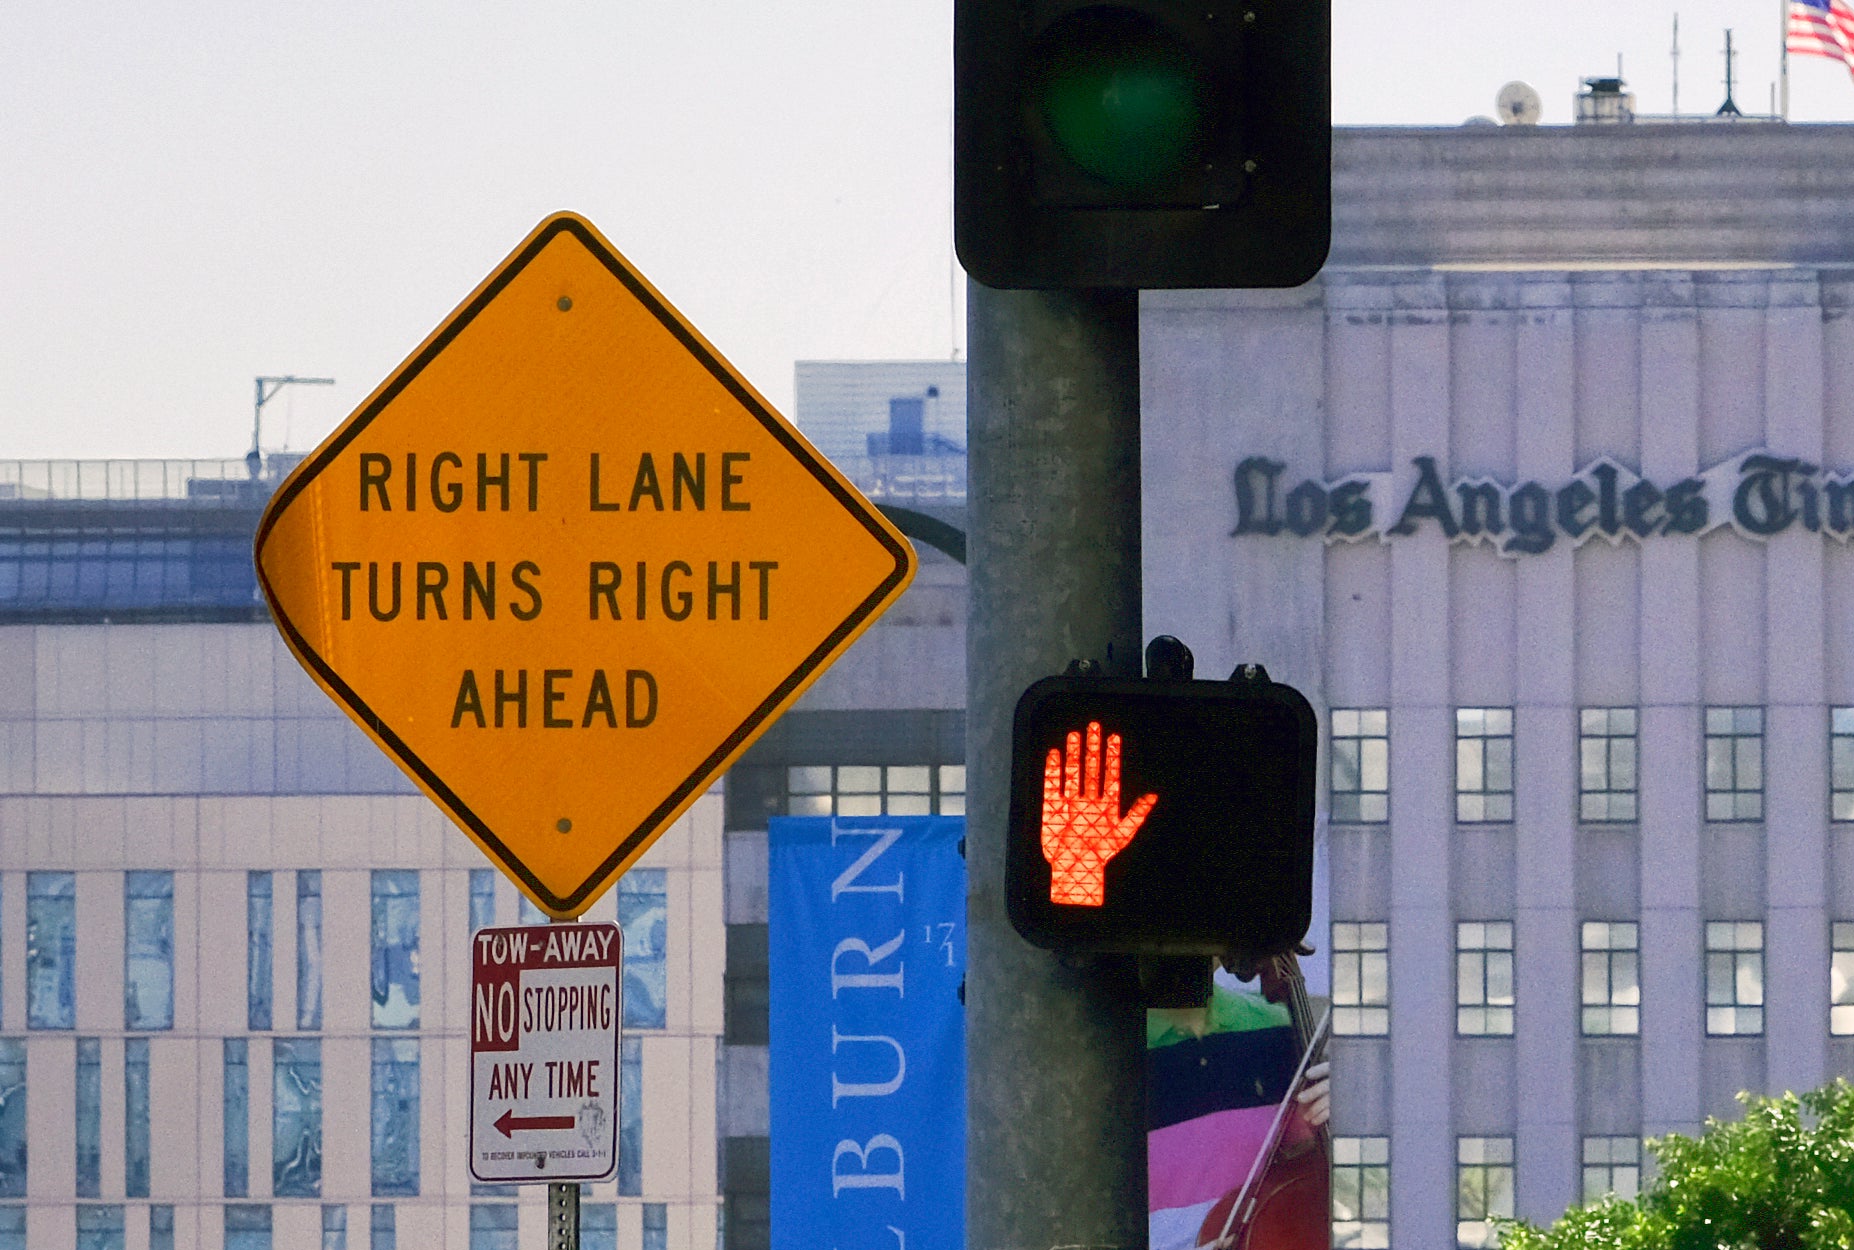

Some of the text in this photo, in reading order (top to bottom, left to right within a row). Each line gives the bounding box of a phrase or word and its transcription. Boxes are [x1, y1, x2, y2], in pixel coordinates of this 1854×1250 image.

[358, 452, 752, 513] RIGHT LANE
[1230, 455, 1374, 537] Los
[1386, 455, 1710, 556] Angeles
[332, 561, 780, 622] TURNS RIGHT
[450, 668, 659, 729] AHEAD
[477, 929, 616, 965] TOW-AWAY
[944, 941, 957, 968] 1
[475, 981, 611, 1043] NO STOPPING
[488, 1060, 600, 1101] ANY TIME
